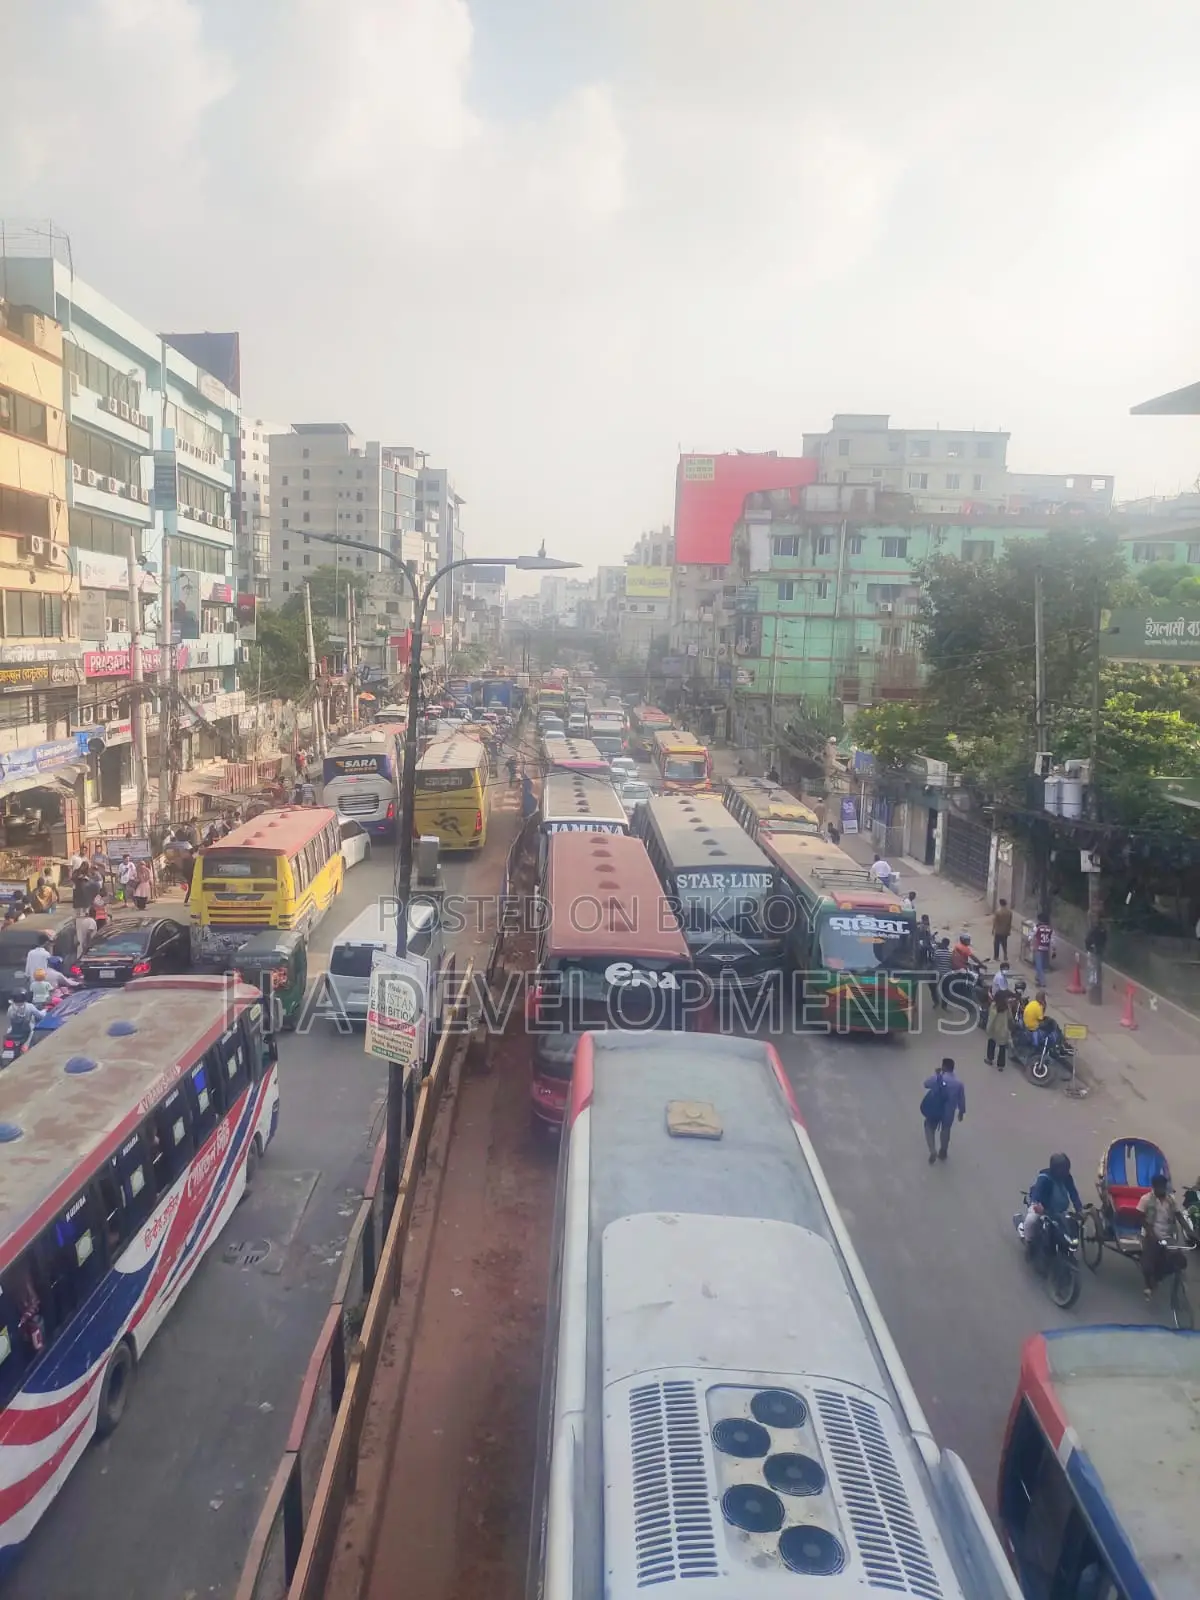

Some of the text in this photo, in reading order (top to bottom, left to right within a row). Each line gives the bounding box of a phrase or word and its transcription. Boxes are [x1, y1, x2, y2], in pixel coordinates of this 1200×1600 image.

[1145, 616, 1185, 638] ইসলামী
[344, 758, 377, 768] SARA
[370, 999, 415, 1023] EXHIBITION
